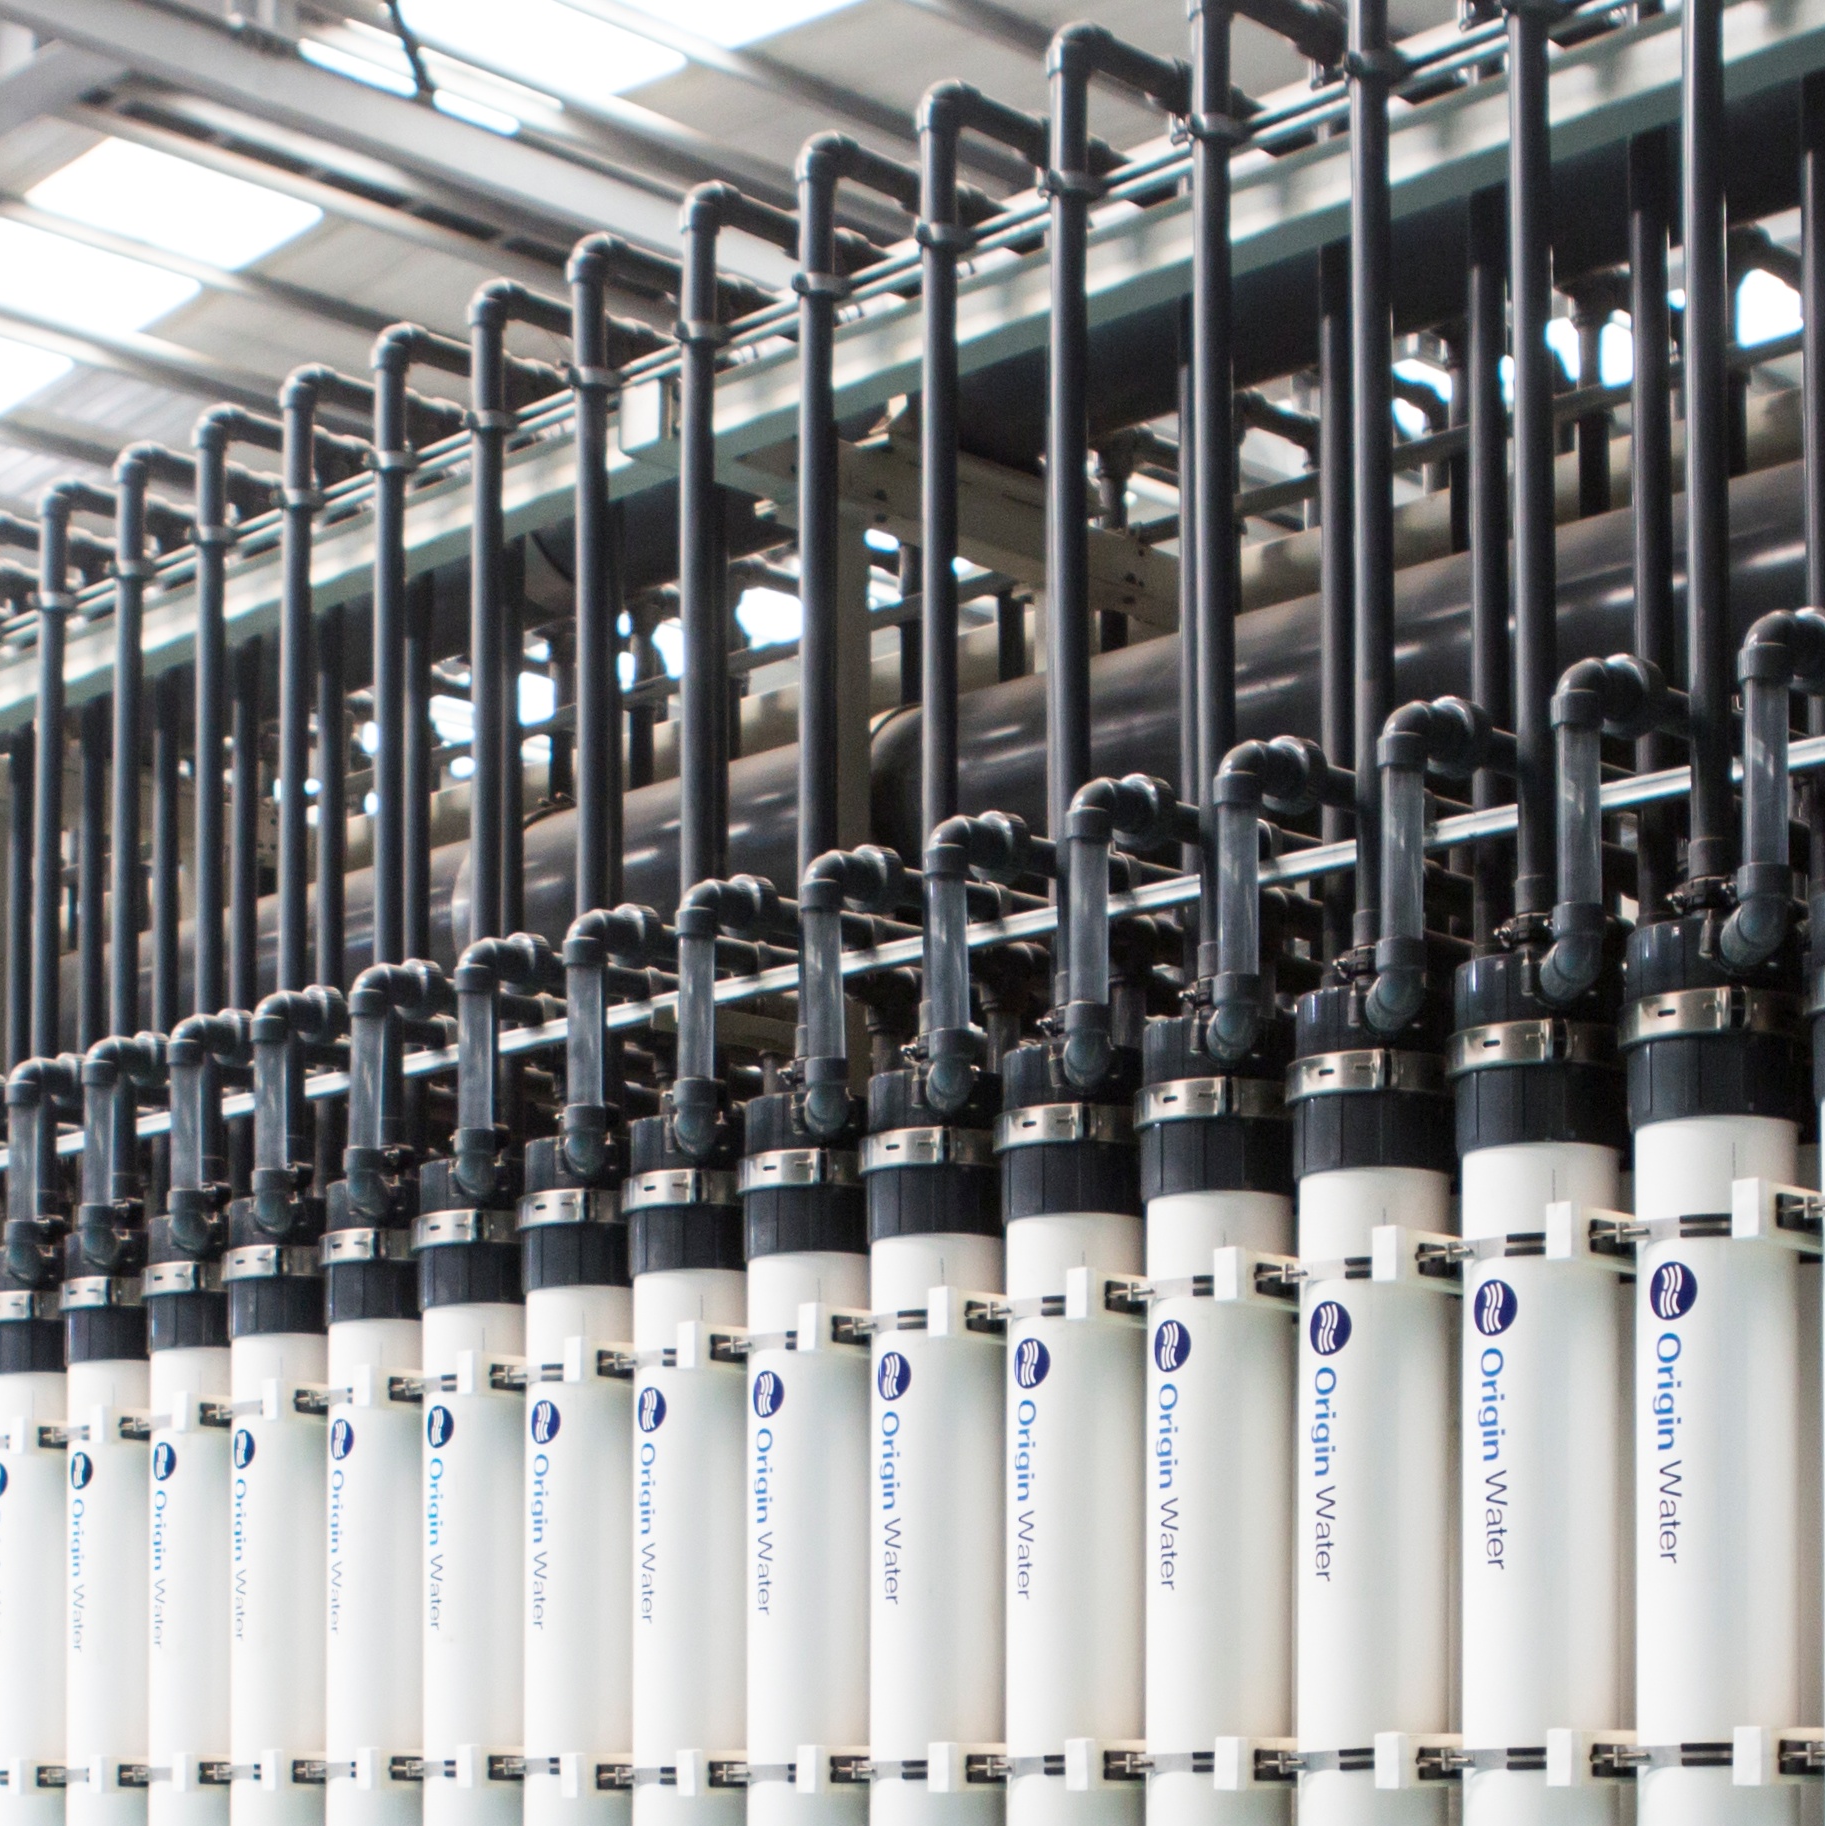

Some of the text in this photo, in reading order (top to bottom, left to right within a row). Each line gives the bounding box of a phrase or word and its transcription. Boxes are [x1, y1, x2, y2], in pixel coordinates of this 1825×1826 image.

[71, 1499, 84, 1577] Origin
[153, 1490, 167, 1571] Origin
[234, 1479, 247, 1561] Origin
[330, 1470, 344, 1554] Origin
[639, 1443, 655, 1622] Origin Water
[755, 1428, 773, 1614] Origin Water
[881, 1411, 901, 1604] Origin Water
[1015, 1400, 1036, 1598] Origin Water
[1157, 1383, 1178, 1590] Origin Water
[1312, 1367, 1336, 1581] Origin Water
[1479, 1348, 1508, 1569] Origin Water
[1654, 1333, 1682, 1563] Origin Water
[428, 1458, 443, 1629] Origin Water
[532, 1454, 549, 1629] Origin Water
